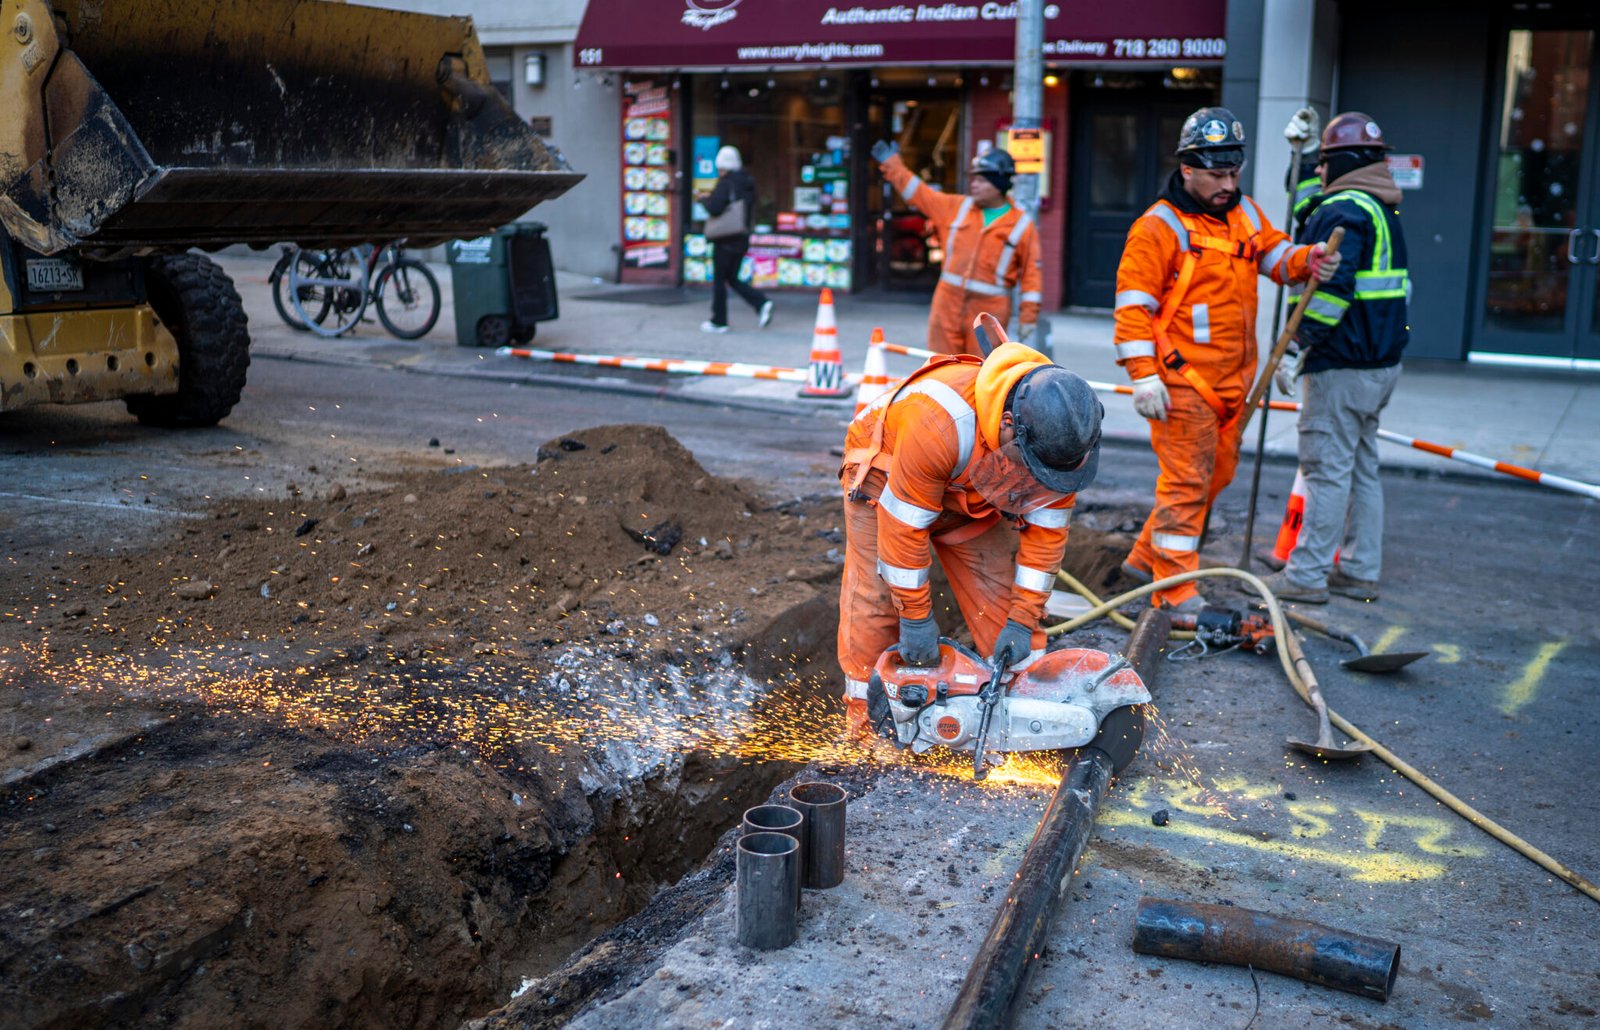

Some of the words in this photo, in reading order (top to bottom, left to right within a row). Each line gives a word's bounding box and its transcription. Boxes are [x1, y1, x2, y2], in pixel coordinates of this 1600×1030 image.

[821, 5, 915, 25] Authentic
[915, 4, 978, 22] Indian
[981, 2, 1060, 20] Cuie
[579, 48, 602, 64] 151
[737, 42, 884, 61] www.curryheights.com
[1056, 39, 1108, 57] Delivery
[1113, 38, 1147, 58] 718
[1183, 37, 1226, 58] 9000
